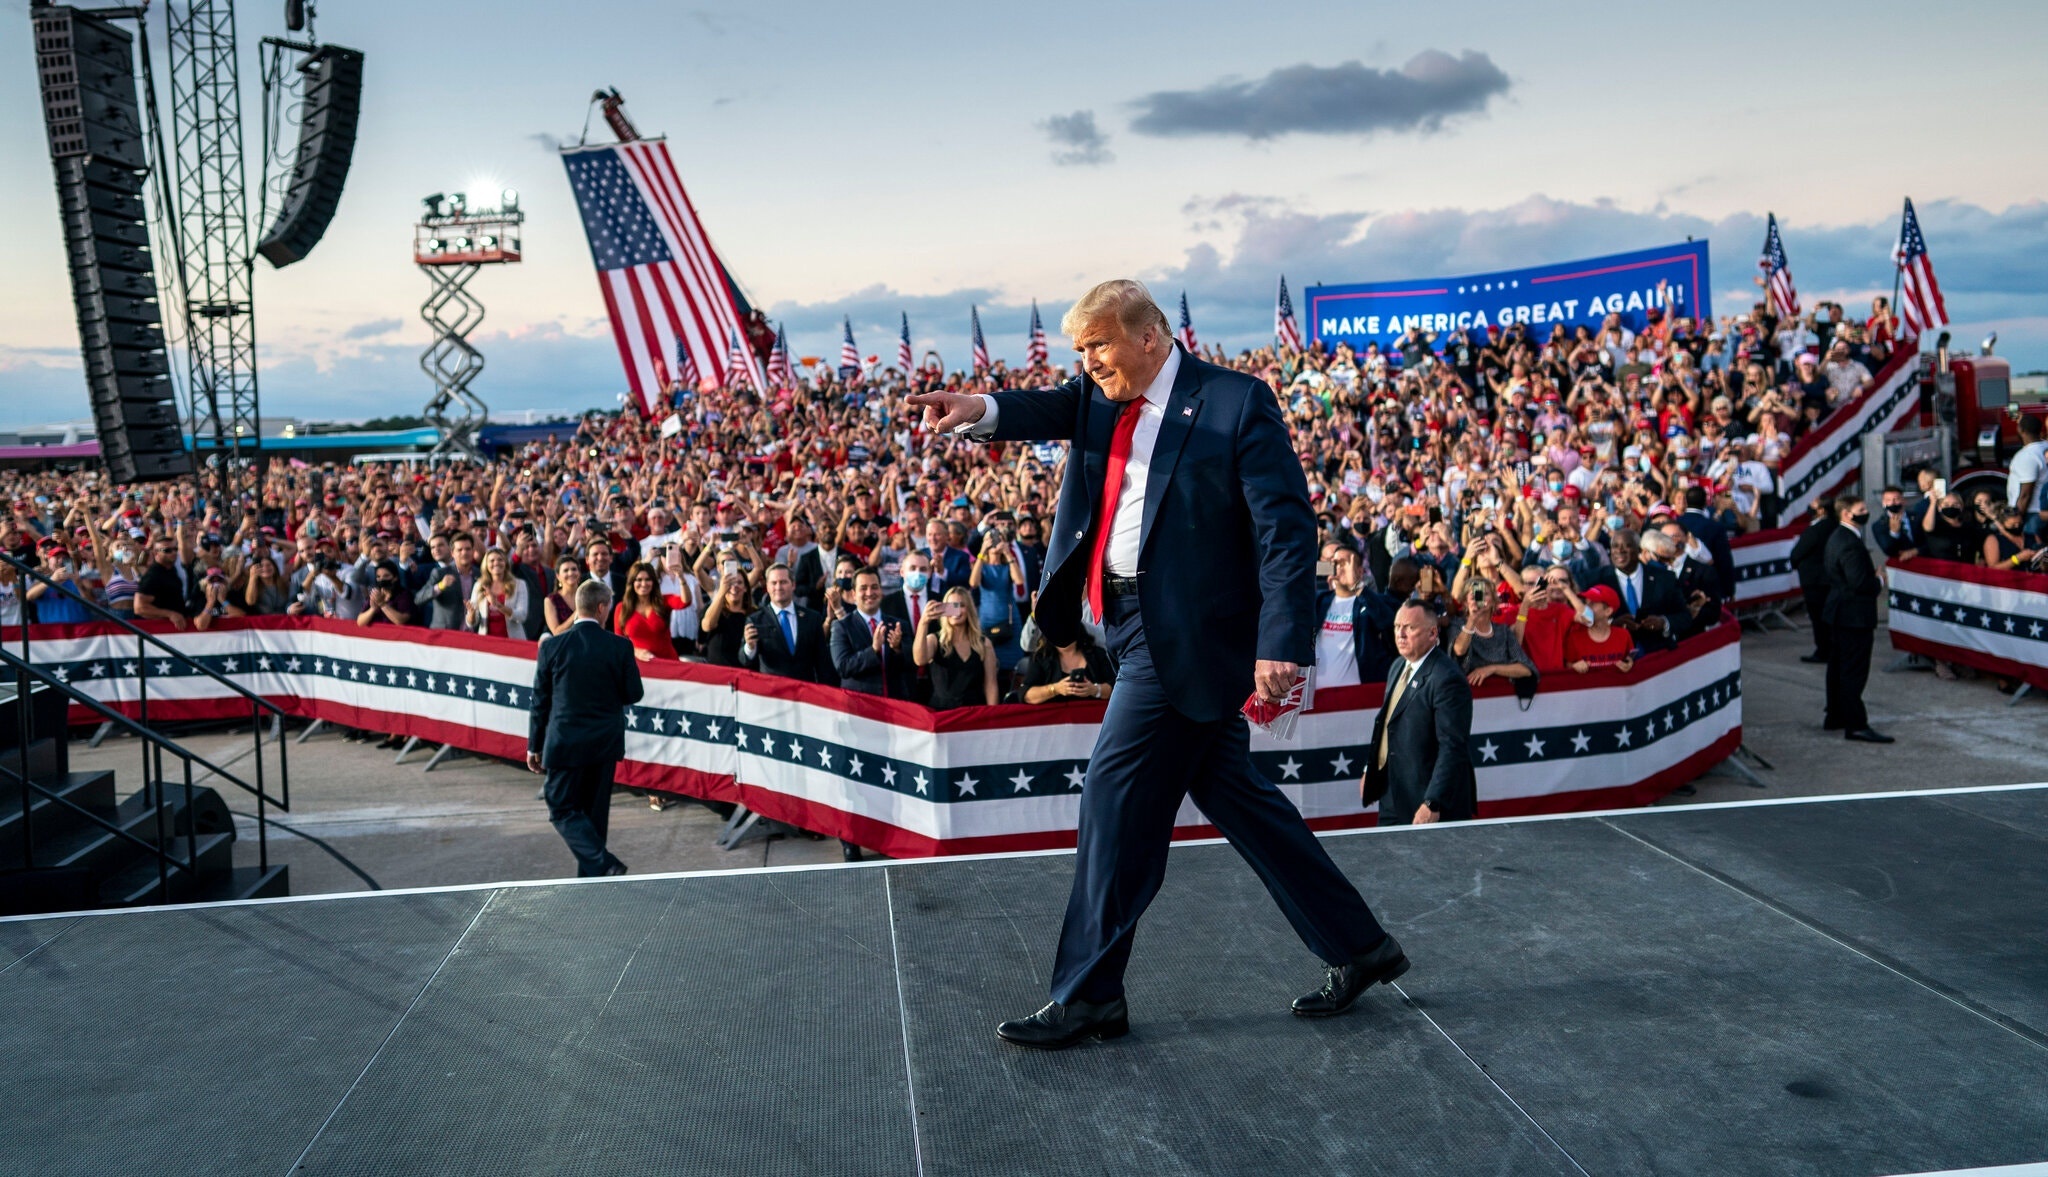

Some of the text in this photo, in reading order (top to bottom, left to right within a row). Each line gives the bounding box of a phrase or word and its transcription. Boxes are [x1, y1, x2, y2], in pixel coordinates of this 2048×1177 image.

[1322, 316, 1380, 336] MAKE
[1387, 310, 1489, 335] AMERICA
[1497, 299, 1580, 327] GREAT
